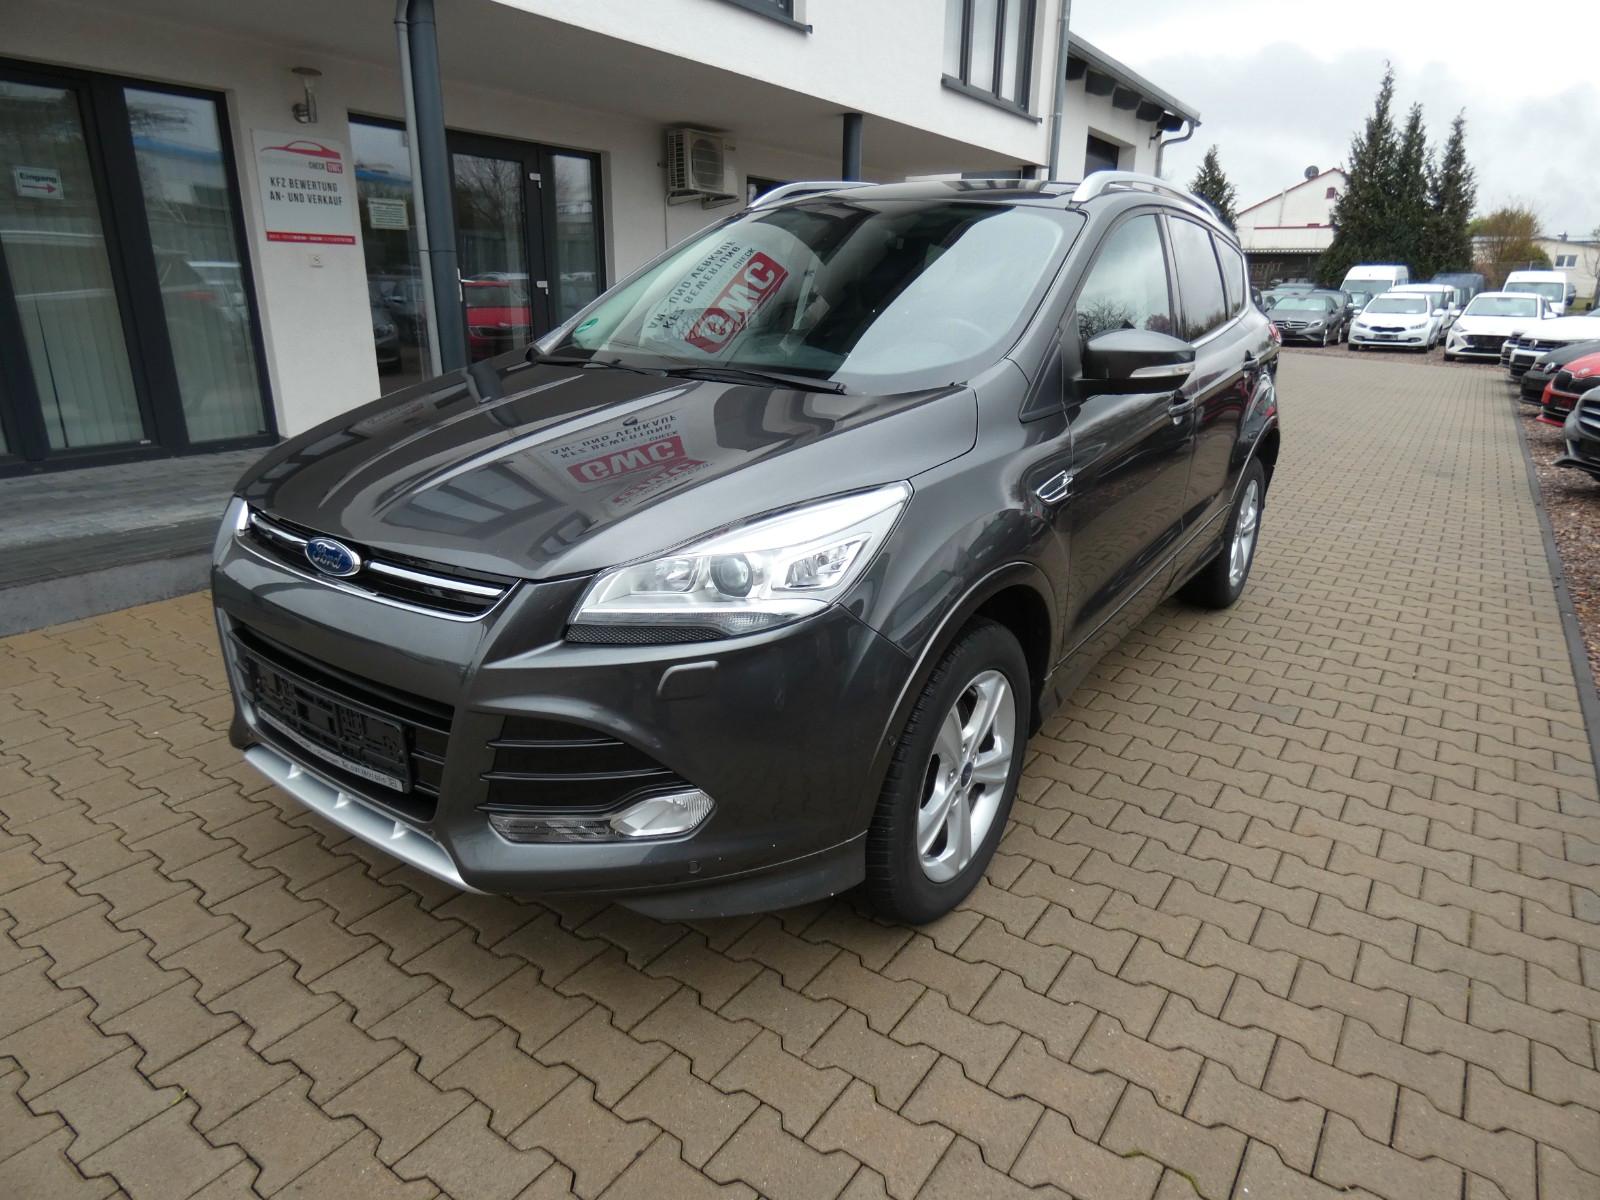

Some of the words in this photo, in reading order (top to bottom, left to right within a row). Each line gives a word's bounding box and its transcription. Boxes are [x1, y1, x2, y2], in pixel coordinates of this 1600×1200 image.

[270, 177, 286, 188] KFZ
[288, 178, 338, 192] BEWERTUNG
[270, 191, 285, 201] AN-
[288, 192, 305, 203] UND
[307, 194, 342, 206] VERKAUF
[312, 541, 343, 569] Ford
